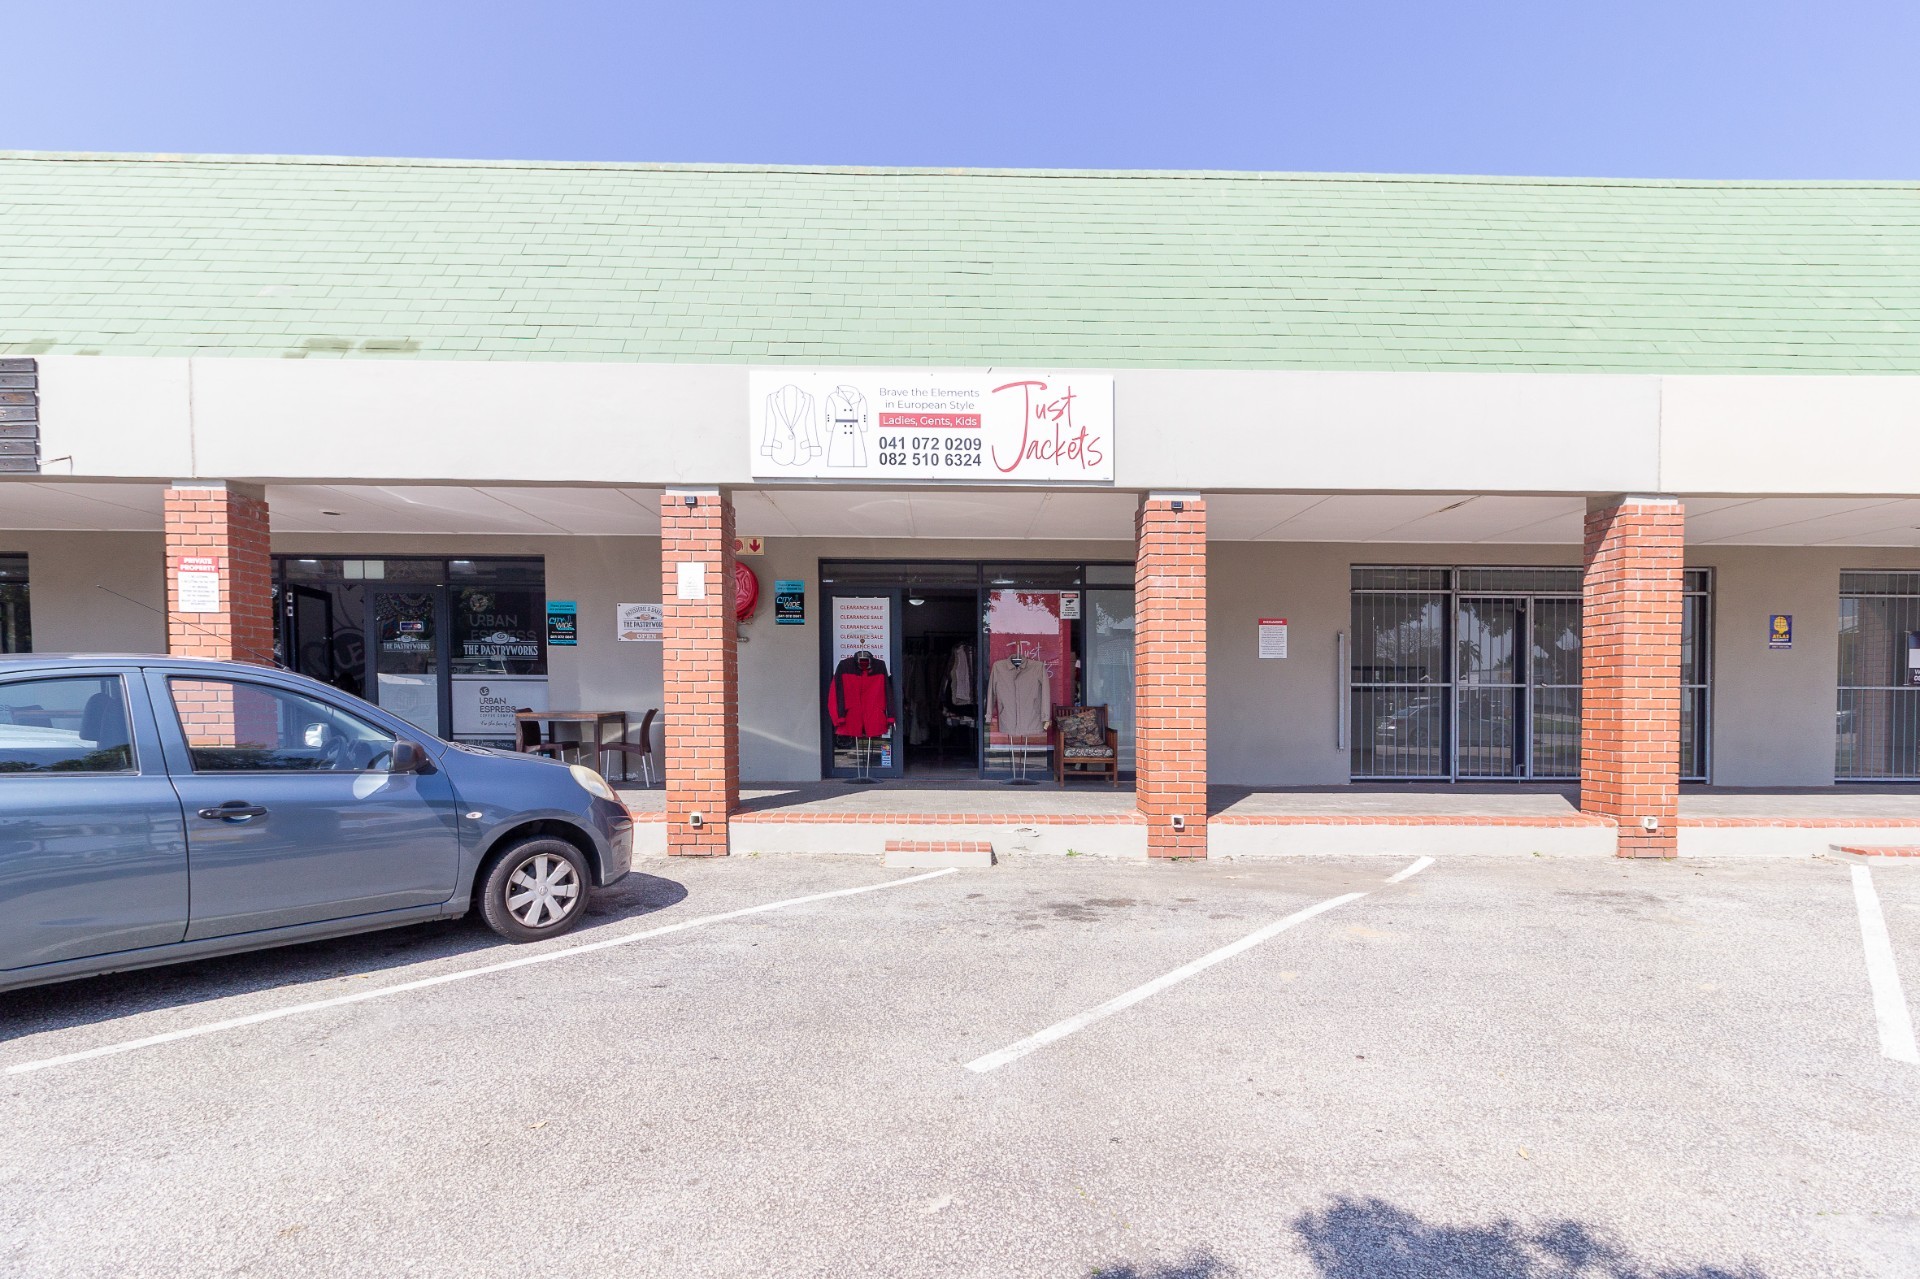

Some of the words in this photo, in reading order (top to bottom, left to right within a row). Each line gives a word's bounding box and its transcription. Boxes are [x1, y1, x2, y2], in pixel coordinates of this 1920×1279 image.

[879, 387, 909, 397] Brave
[911, 388, 928, 397] the
[930, 388, 980, 398] Elements
[885, 400, 895, 409] in
[897, 400, 947, 410] European
[949, 401, 975, 411] Style
[882, 415, 919, 426] Ladies,
[920, 416, 953, 427] Gents,
[955, 416, 978, 426] Kids
[879, 436, 906, 450] 041
[912, 436, 940, 451] 072
[944, 437, 982, 451] 0209
[879, 452, 907, 466] 082
[912, 452, 940, 467] 510
[944, 453, 982, 467] 6324
[183, 557, 213, 565] PRIVATE
[179, 564, 216, 572] PROPERTY
[463, 644, 479, 655] THE
[480, 645, 539, 656] PASTRYWORKS
[479, 697, 507, 705] URBAN
